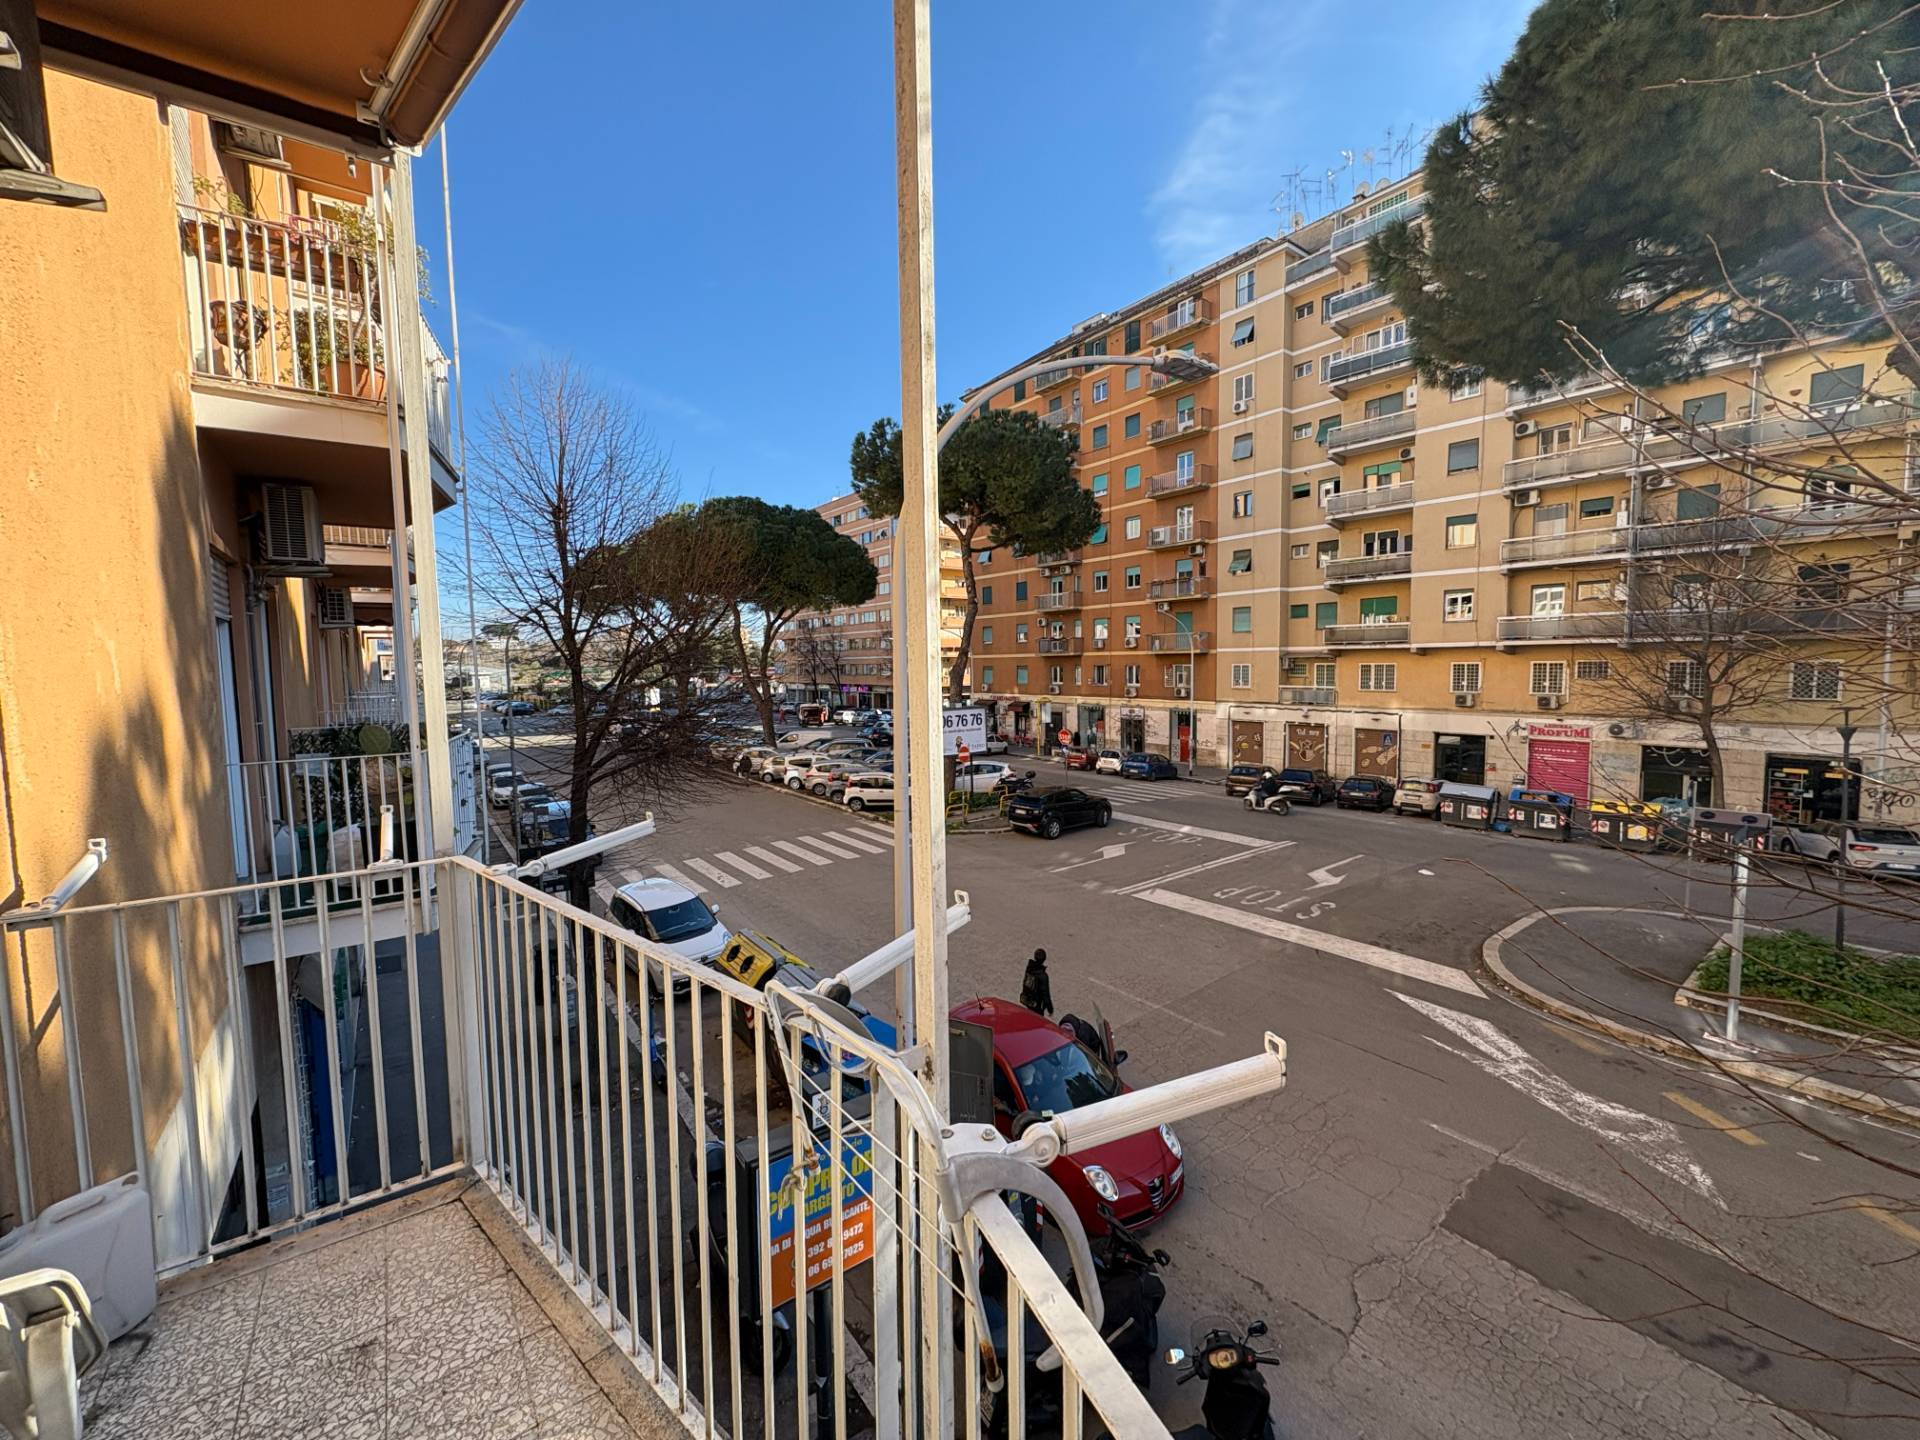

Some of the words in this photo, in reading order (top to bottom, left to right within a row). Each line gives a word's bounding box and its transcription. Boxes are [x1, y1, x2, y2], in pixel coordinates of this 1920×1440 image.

[955, 714, 968, 727] 76
[970, 713, 983, 726] 76
[1529, 725, 1590, 738] PROFUMI
[1213, 885, 1336, 919] STOP
[782, 1238, 792, 1250] DI
[807, 1241, 825, 1258] 392
[808, 1263, 820, 1277] 06
